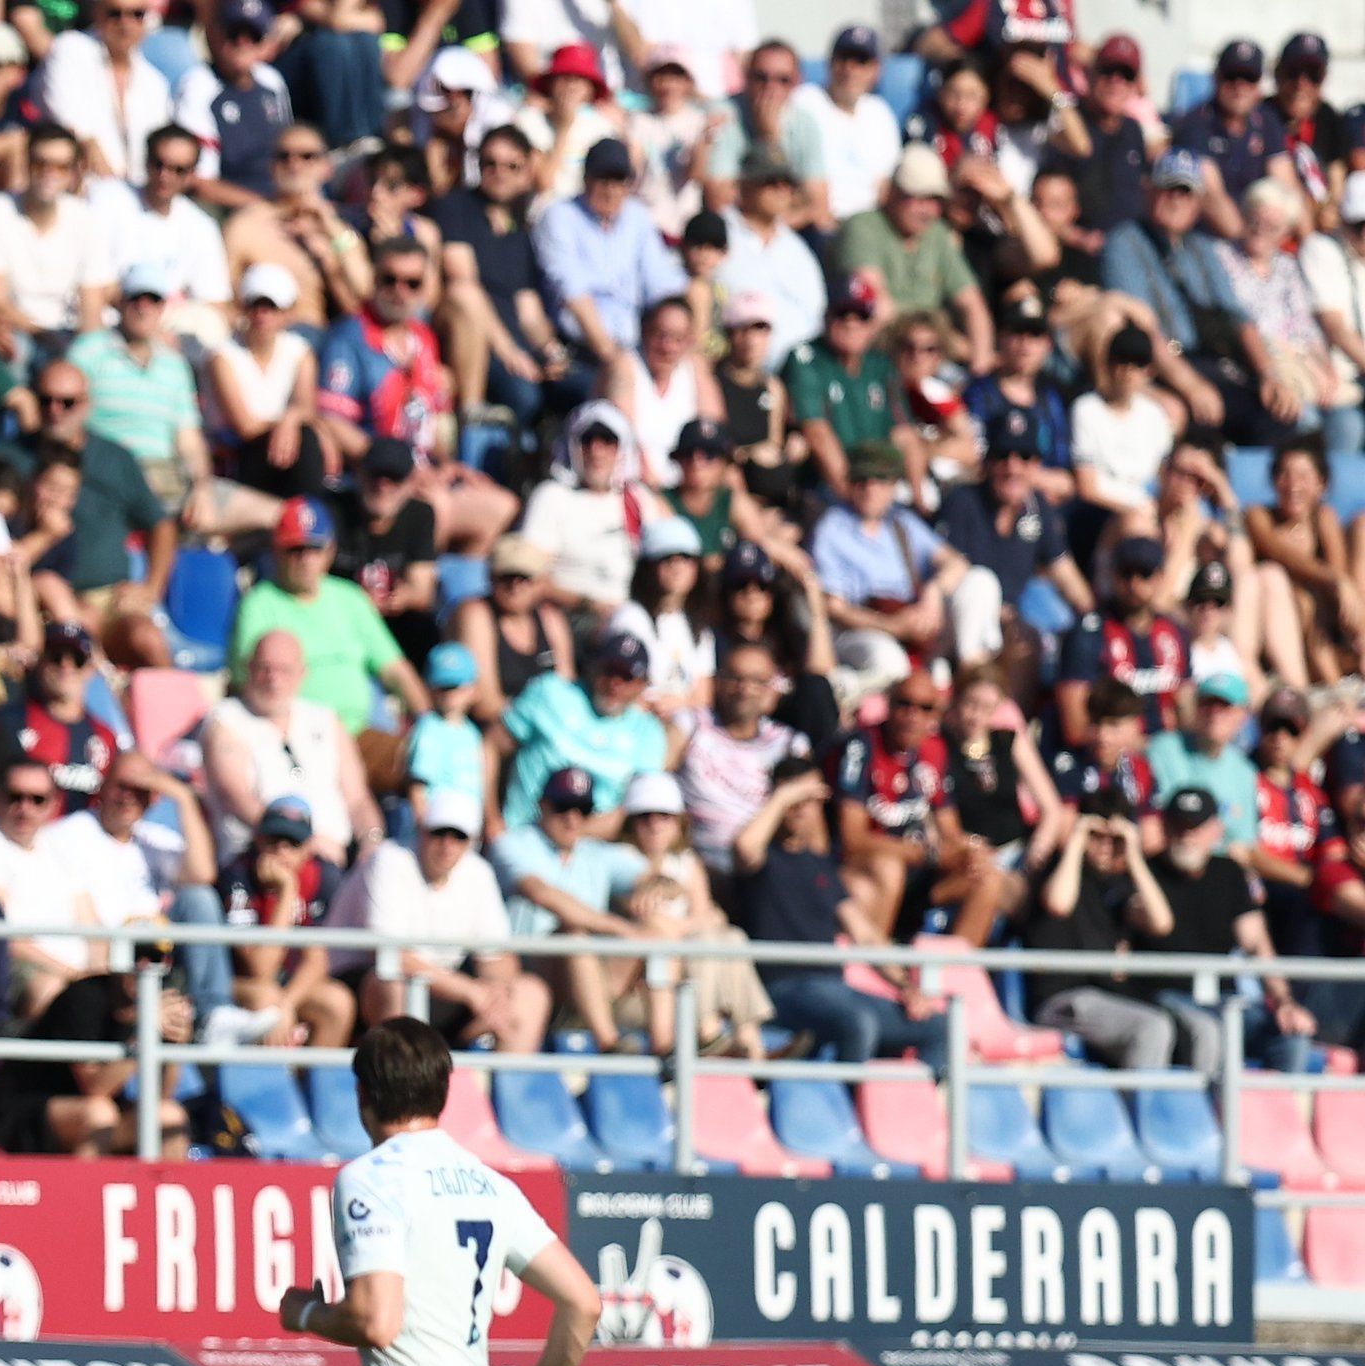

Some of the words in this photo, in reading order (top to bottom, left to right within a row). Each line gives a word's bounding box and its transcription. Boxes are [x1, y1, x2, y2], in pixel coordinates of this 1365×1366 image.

[577, 1191, 664, 1219] BOLOGNA
[664, 1193, 713, 1220] CLUB
[753, 1201, 1234, 1327] CALDERARA
[456, 1220, 493, 1346] 7
